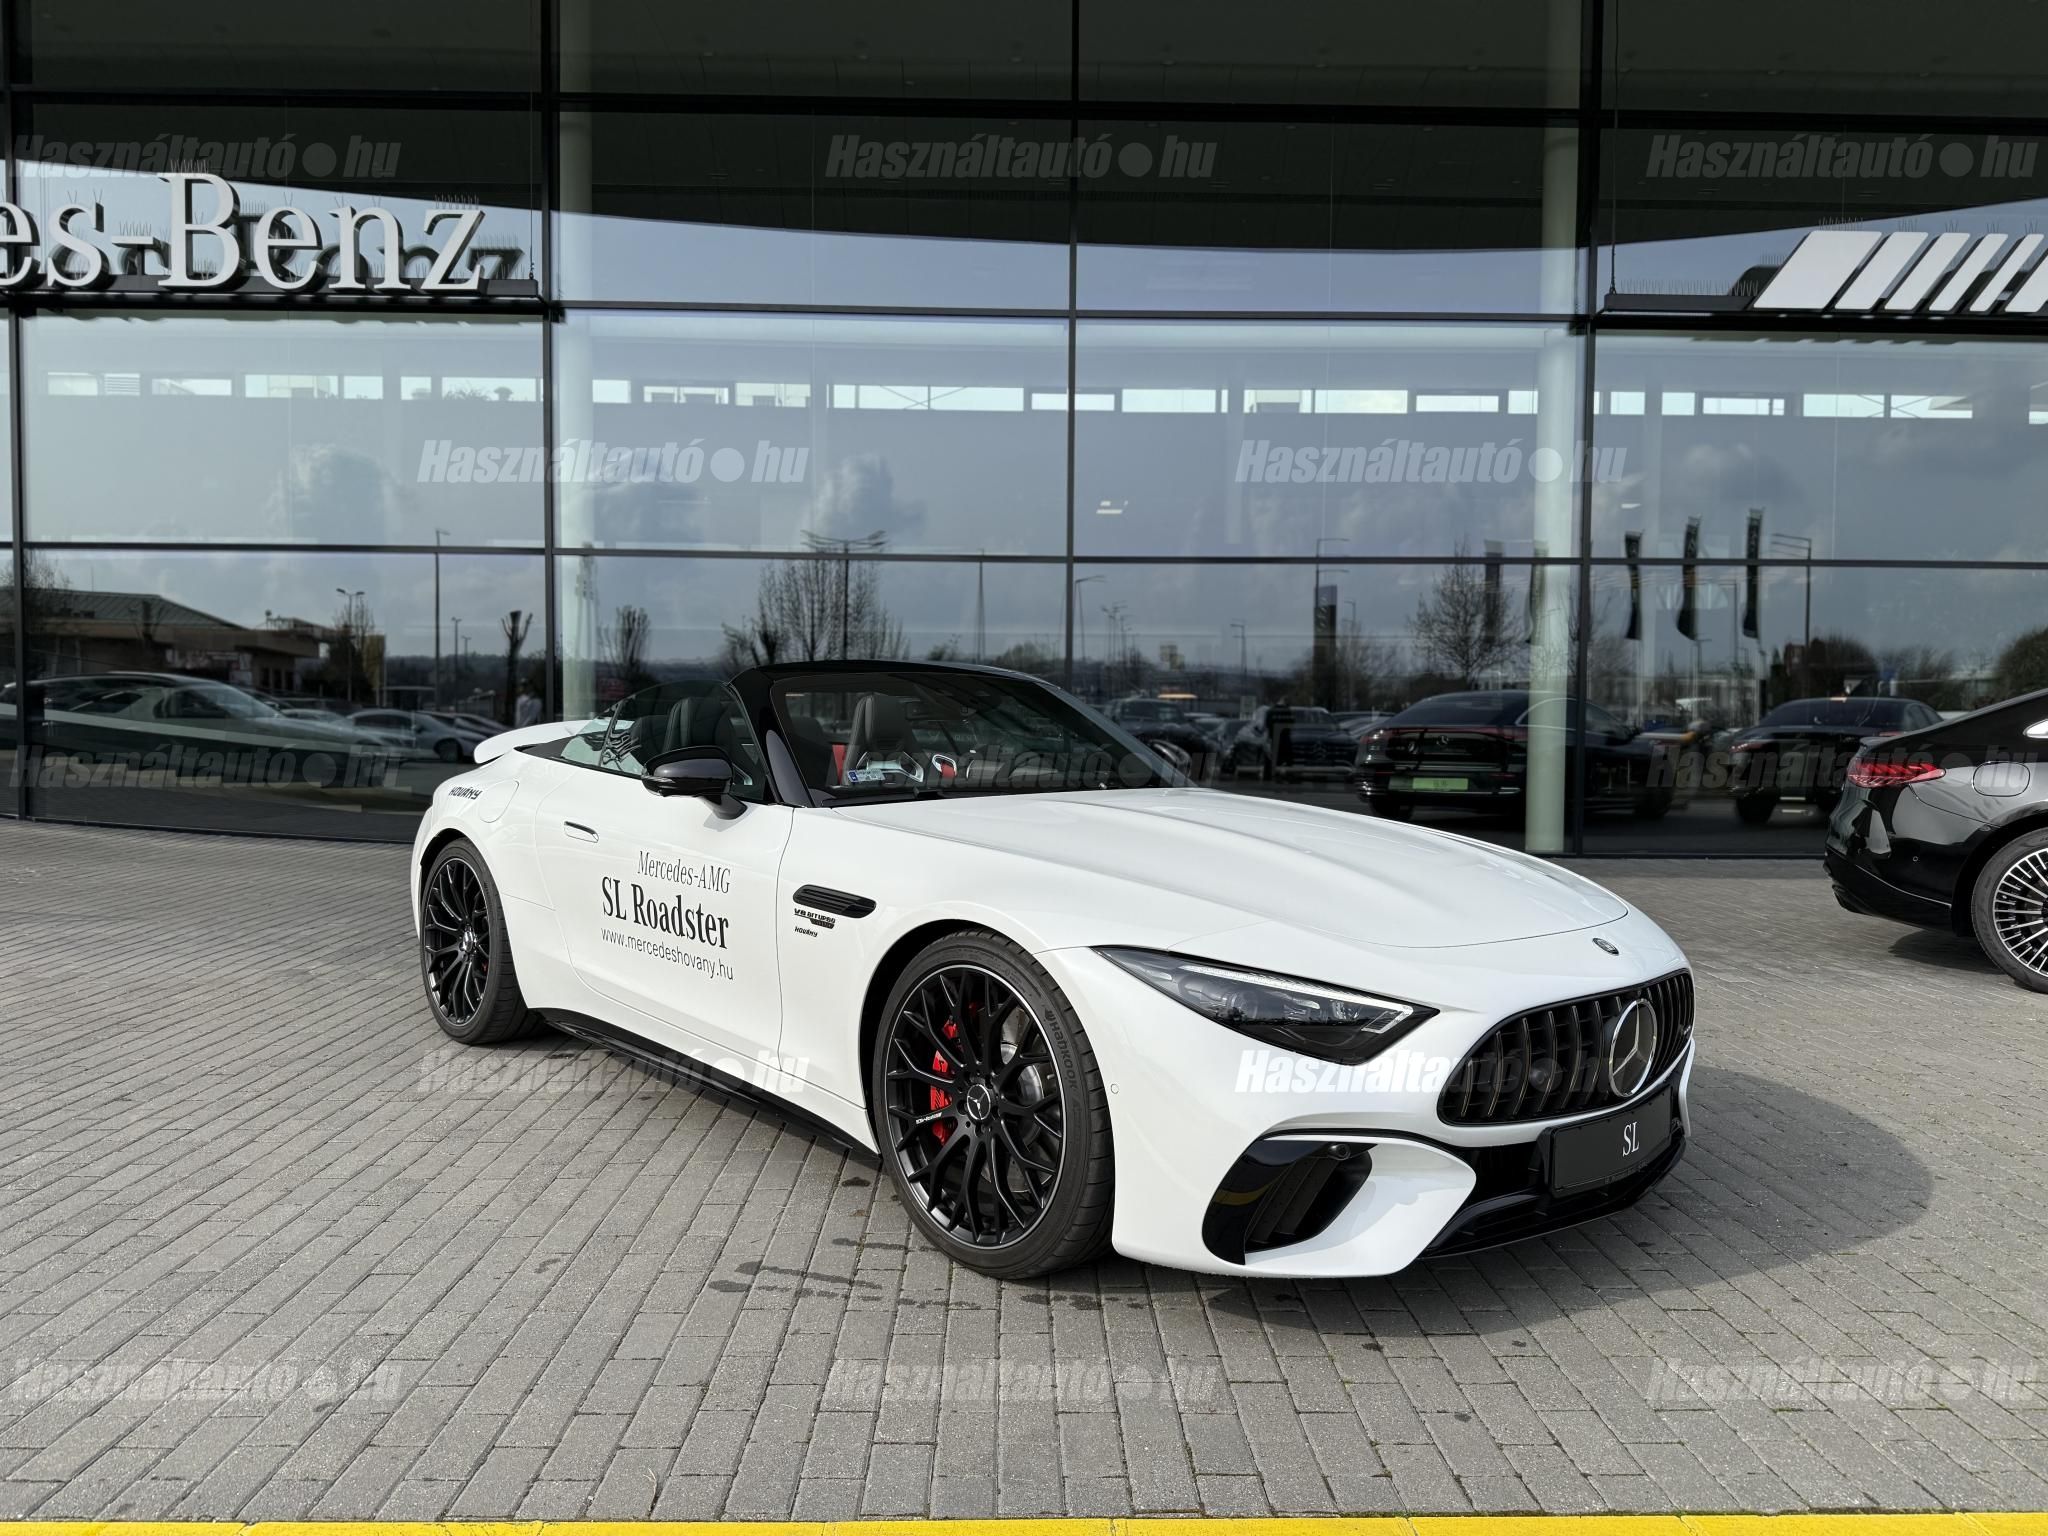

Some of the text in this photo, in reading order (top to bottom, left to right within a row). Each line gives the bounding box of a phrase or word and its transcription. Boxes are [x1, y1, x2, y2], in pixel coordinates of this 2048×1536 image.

[637, 850, 731, 894] Mercedes-AMG
[601, 876, 729, 949] SL Roadster
[601, 927, 734, 981] www.mercedeshovany.hu
[1622, 1121, 1640, 1157] SL
